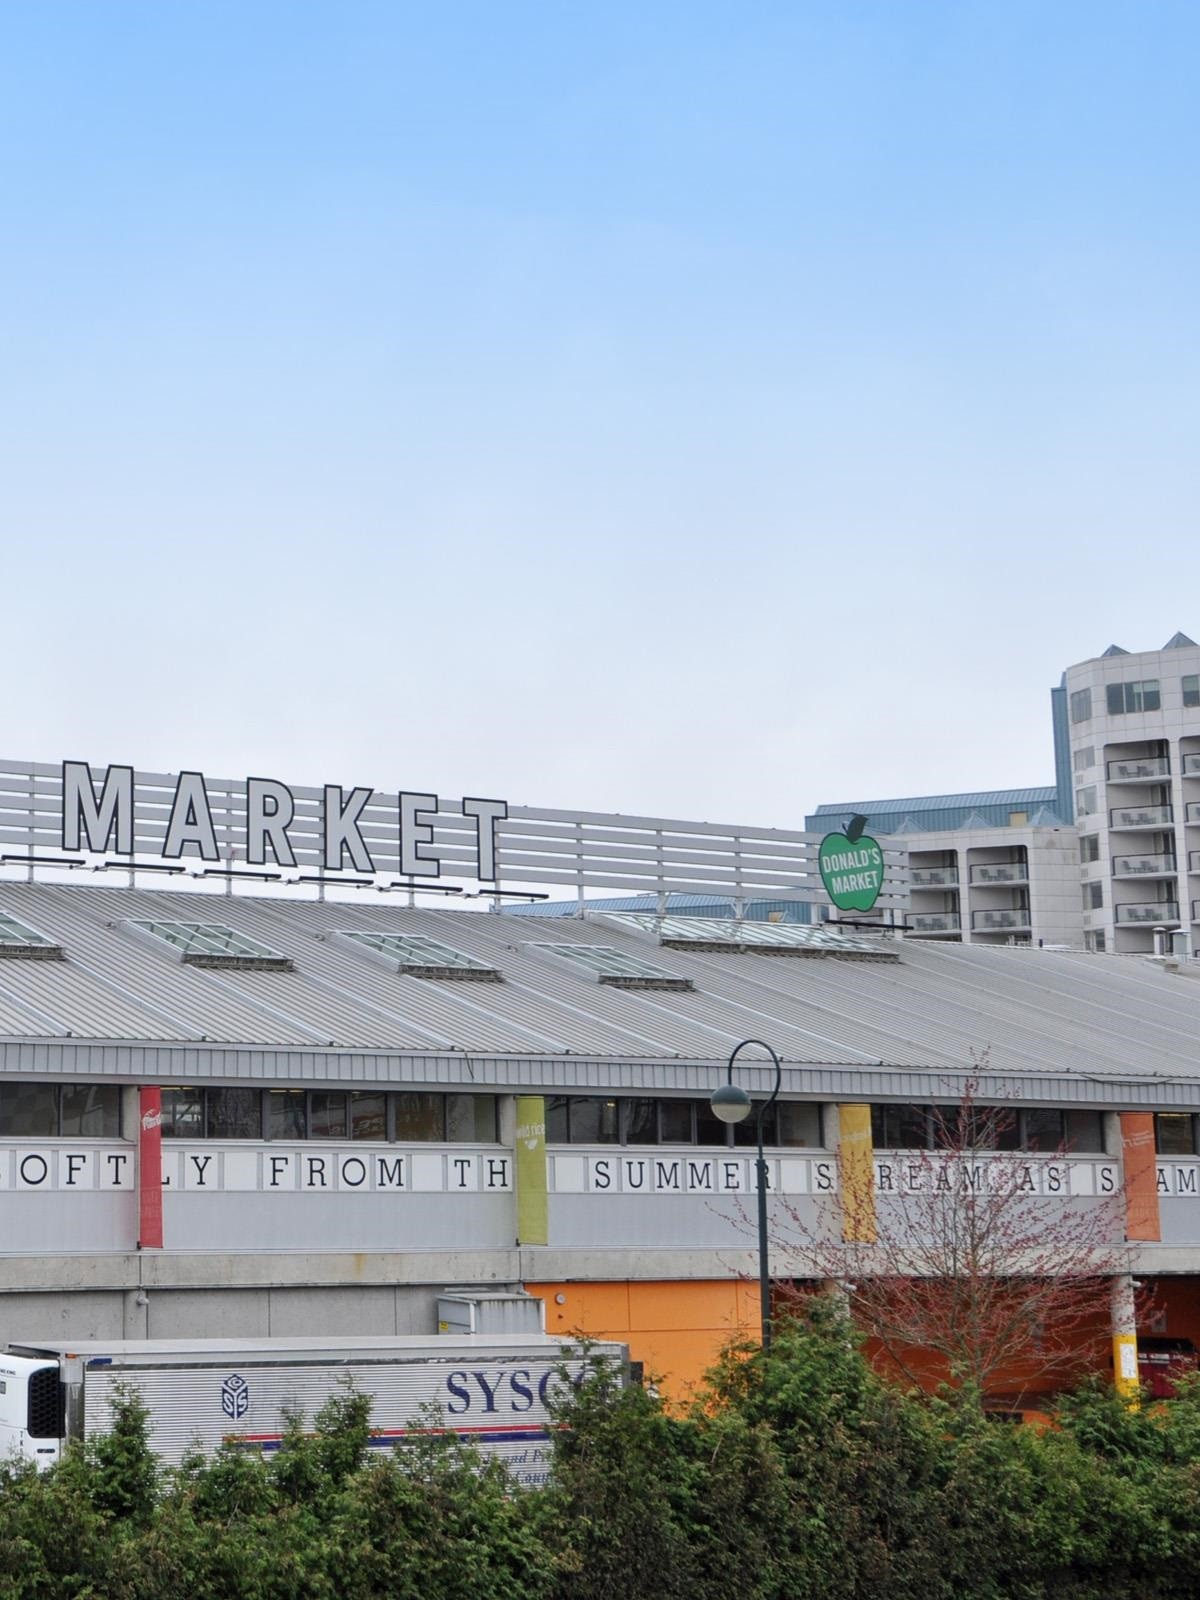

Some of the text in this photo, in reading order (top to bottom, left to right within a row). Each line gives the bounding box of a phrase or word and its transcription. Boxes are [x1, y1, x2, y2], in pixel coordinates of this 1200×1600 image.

[61, 760, 508, 882] MARKET
[822, 848, 881, 873] DONALD'S
[832, 871, 878, 894] MARKET
[270, 1157, 404, 1187] FROM
[595, 1161, 772, 1190] SUMMER
[816, 1163, 982, 1191] SREAM
[1021, 1166, 1061, 1192] AS
